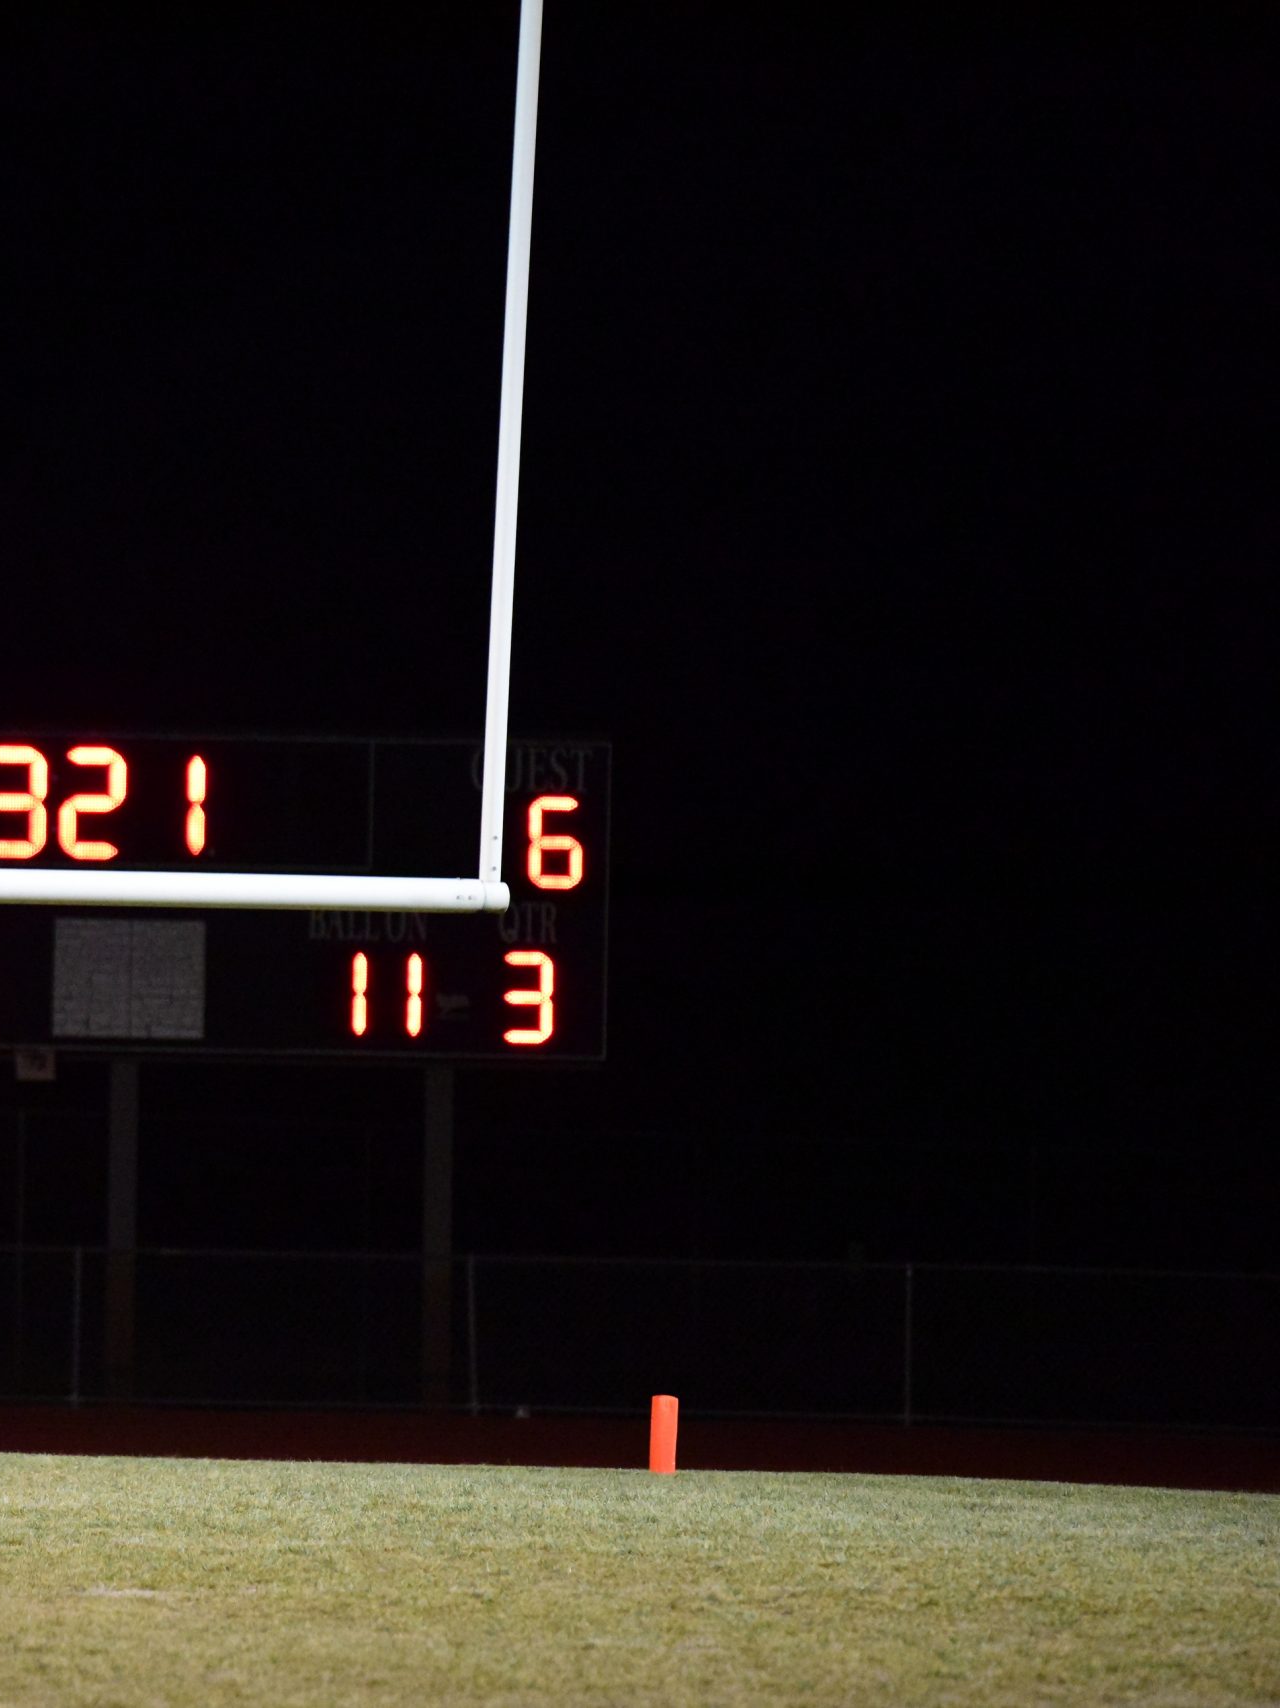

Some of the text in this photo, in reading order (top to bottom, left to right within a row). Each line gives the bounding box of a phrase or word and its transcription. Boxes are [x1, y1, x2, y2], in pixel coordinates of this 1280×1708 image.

[526, 795, 584, 890] 6
[498, 901, 558, 943] QTR
[503, 950, 555, 1045] 3
